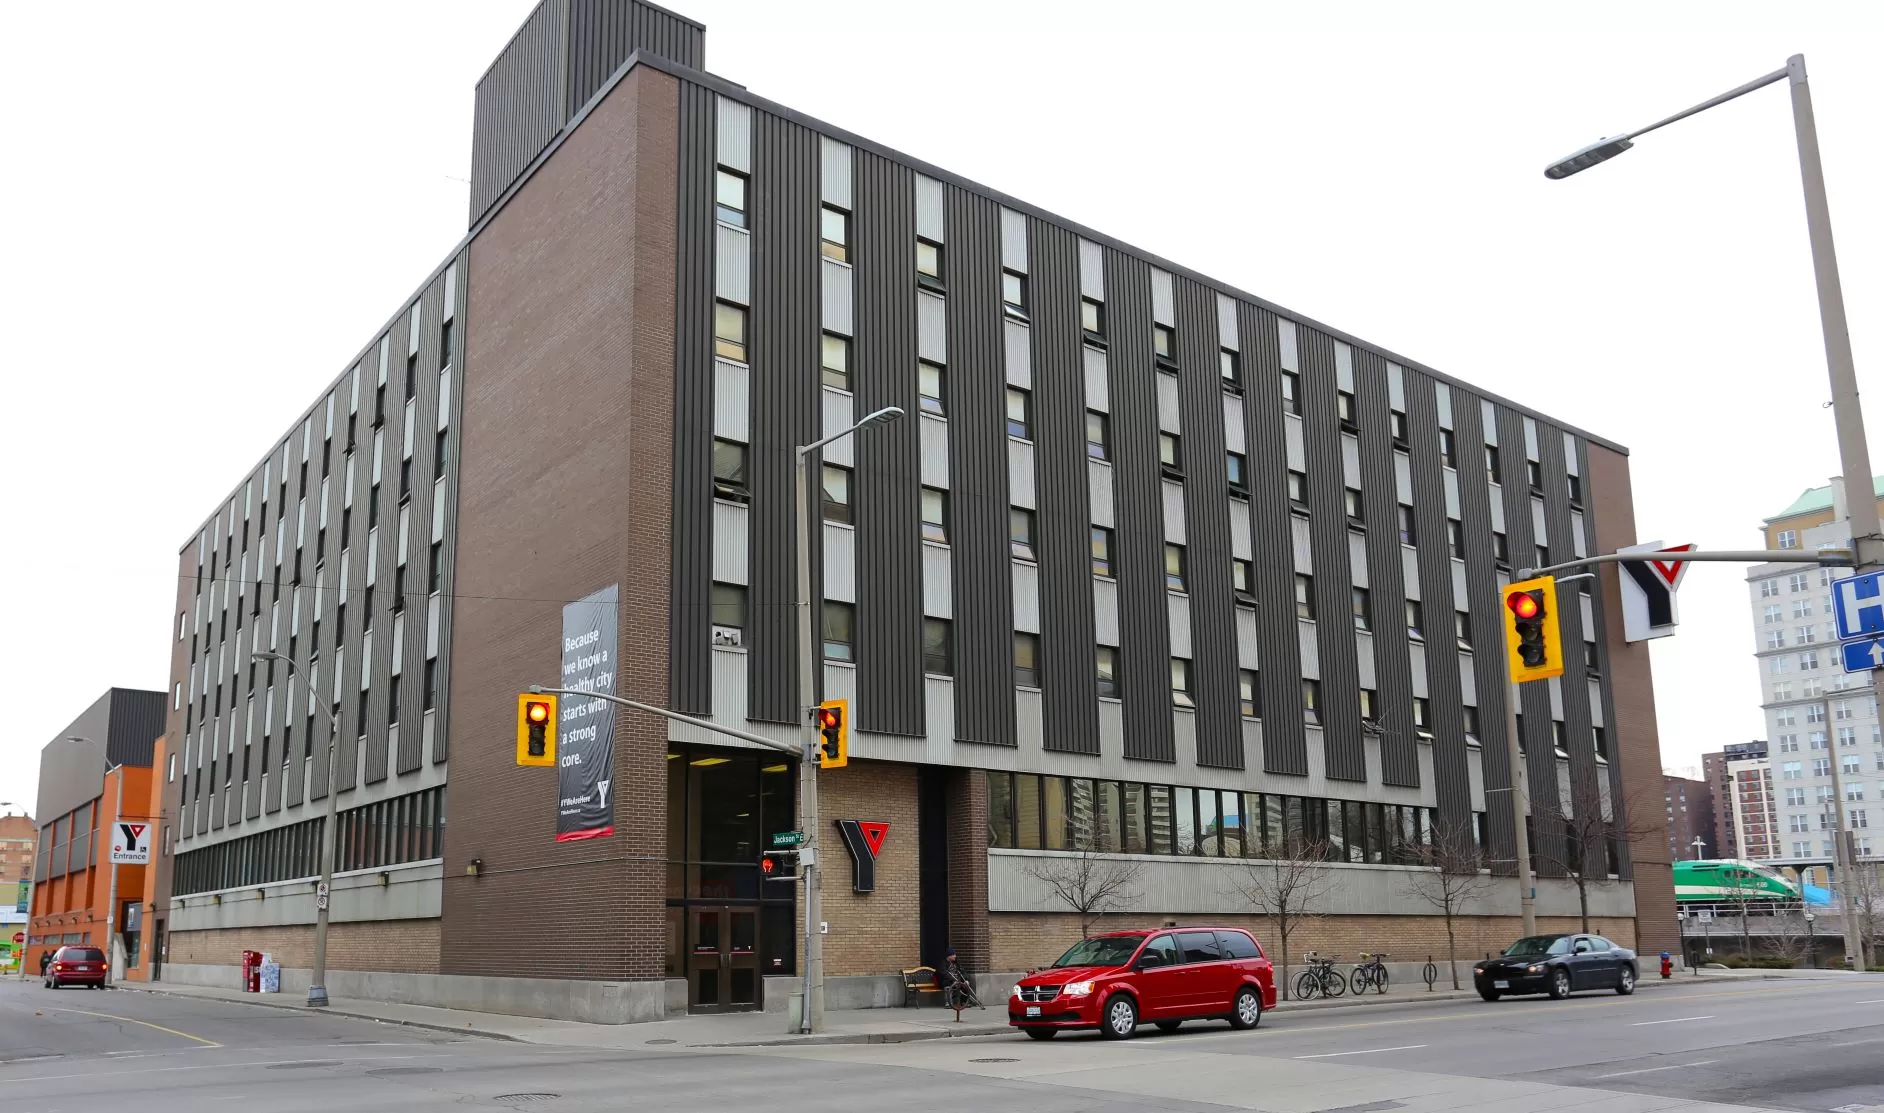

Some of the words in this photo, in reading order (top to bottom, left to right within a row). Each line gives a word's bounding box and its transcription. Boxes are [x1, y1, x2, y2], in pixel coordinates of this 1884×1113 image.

[1841, 573, 1884, 633] H
[565, 630, 599, 652] Because
[564, 662, 576, 676] we
[577, 653, 601, 671] know
[602, 650, 608, 662] a
[564, 677, 596, 699] healthy
[596, 671, 612, 688] city
[563, 703, 587, 722] starts
[588, 696, 607, 714] with
[562, 732, 568, 745] a
[568, 725, 597, 743] strong
[561, 753, 582, 768] core.
[773, 834, 796, 844] Jackson
[113, 852, 147, 860] Entrance
